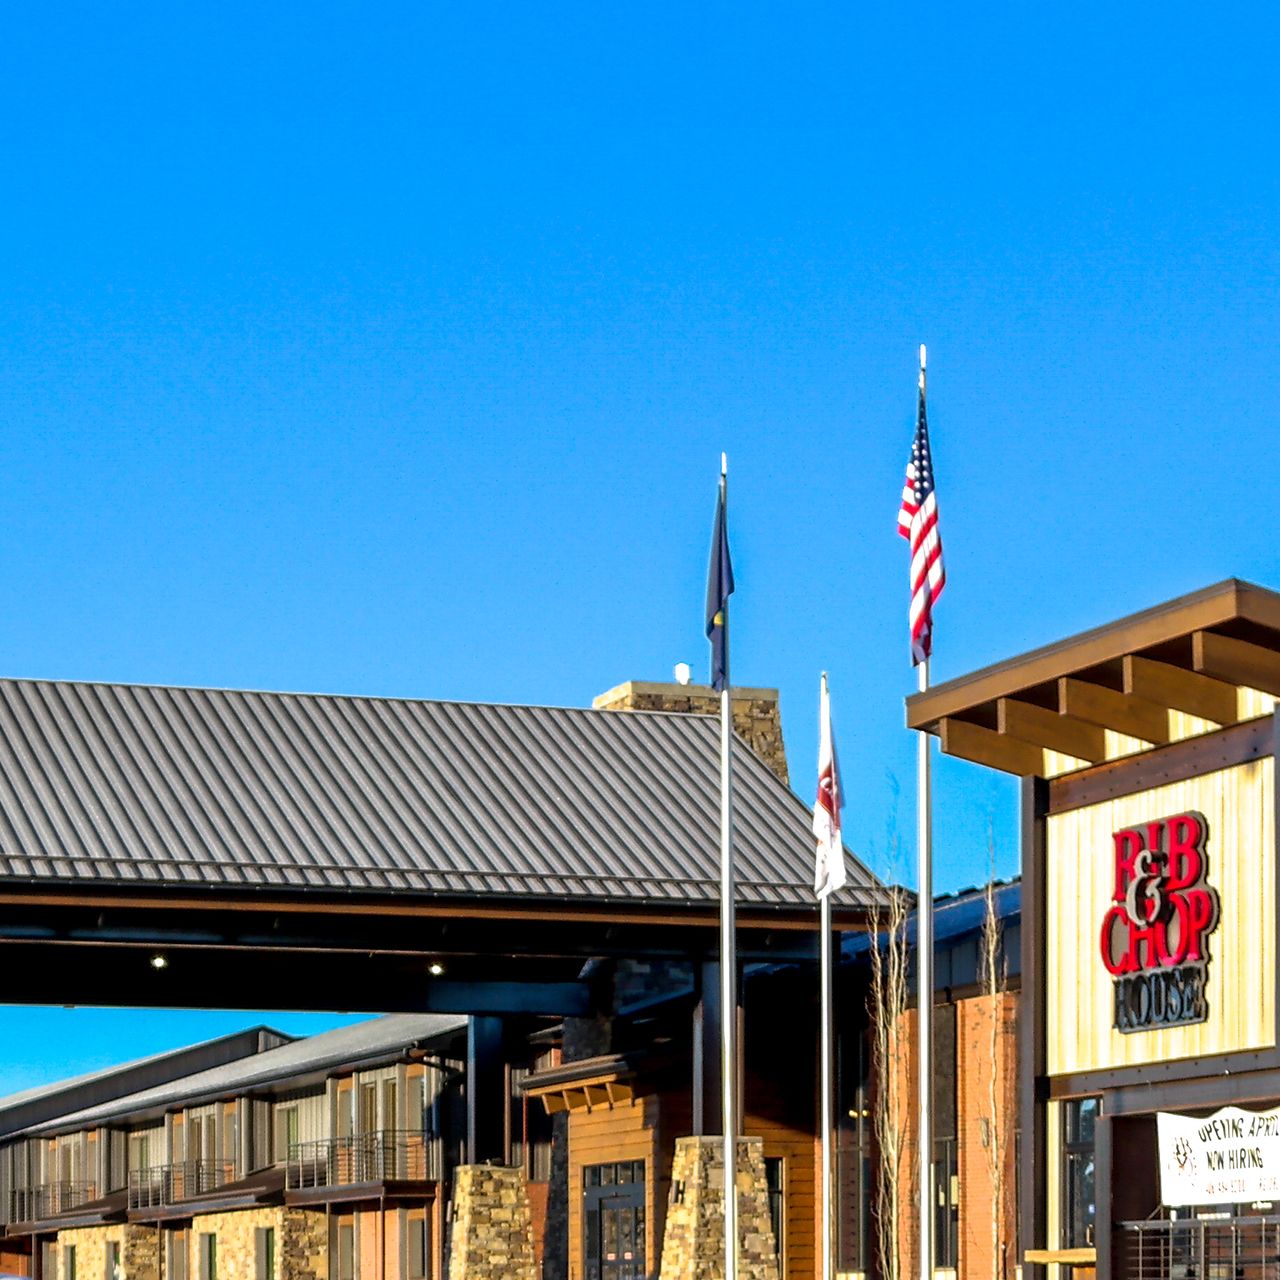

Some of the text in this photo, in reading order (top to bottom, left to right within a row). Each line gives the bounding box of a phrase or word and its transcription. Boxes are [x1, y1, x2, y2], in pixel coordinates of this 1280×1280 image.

[1112, 814, 1201, 902] RIB
[1100, 890, 1212, 977] CHOP
[1112, 965, 1204, 1029] HOUSE
[1206, 1149, 1225, 1171] NOW
[1228, 1147, 1264, 1169] HIRING
